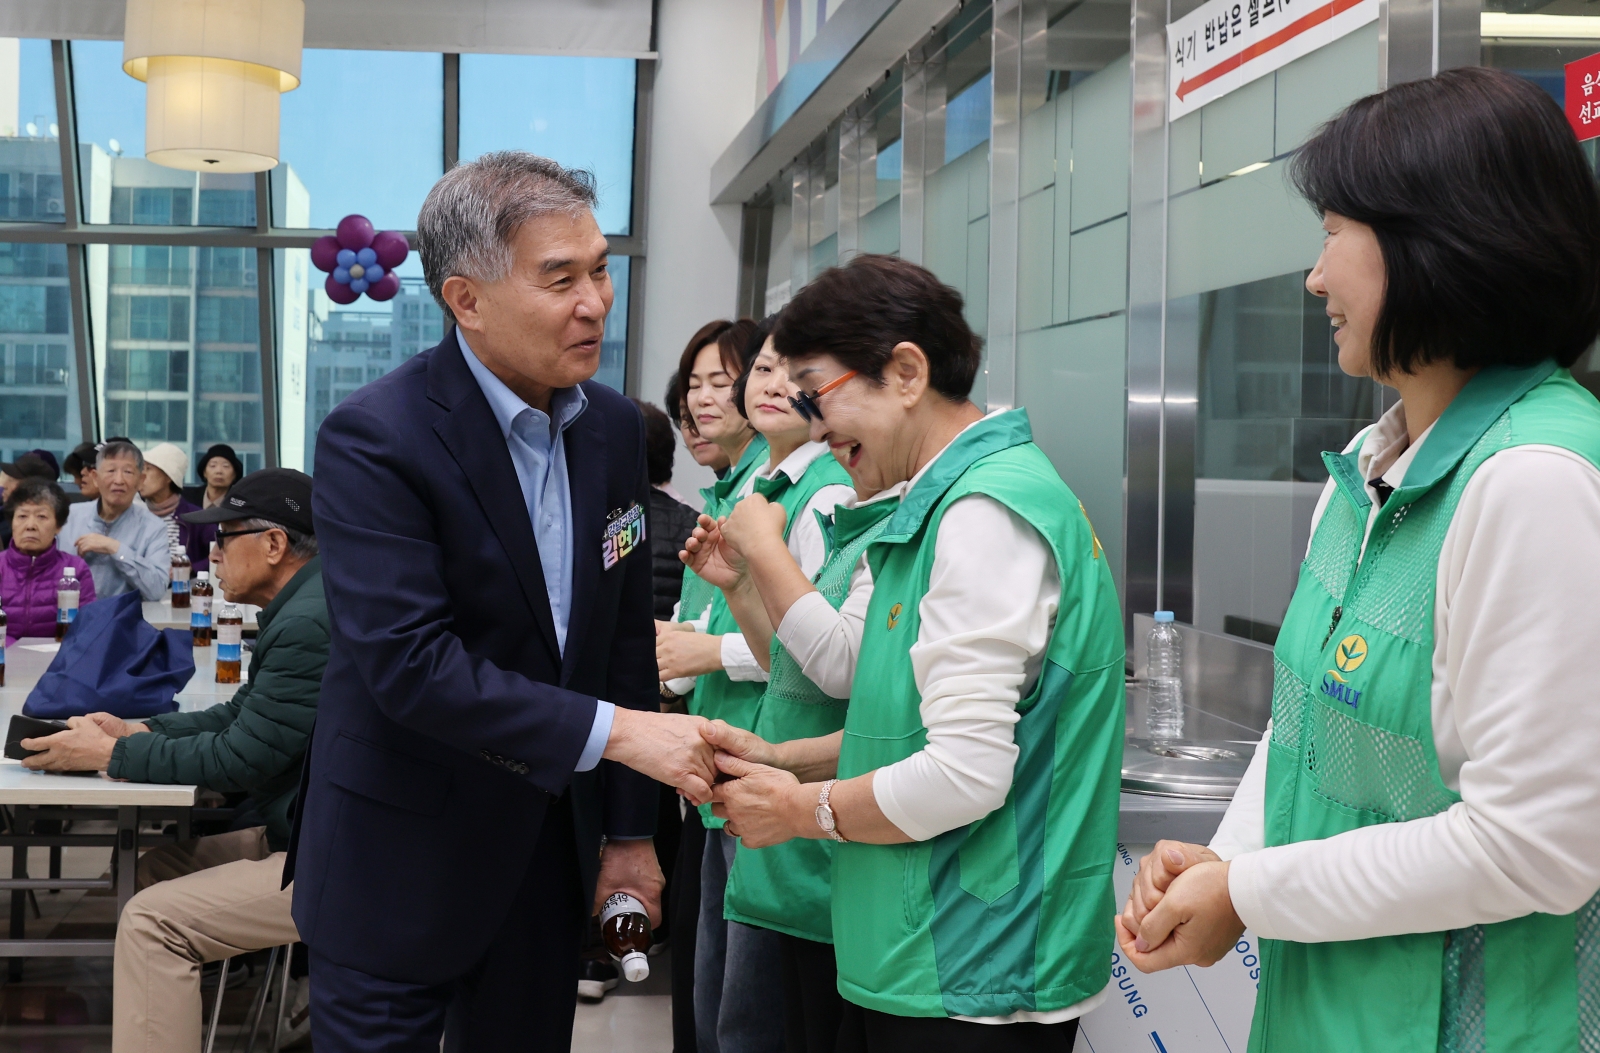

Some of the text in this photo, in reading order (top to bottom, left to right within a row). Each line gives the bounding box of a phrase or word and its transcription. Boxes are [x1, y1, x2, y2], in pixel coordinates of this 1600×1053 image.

[1175, 30, 1196, 67] 식기
[1205, 4, 1241, 53] 반납은
[602, 513, 646, 570] 김현기
[1320, 673, 1361, 708] SMU
